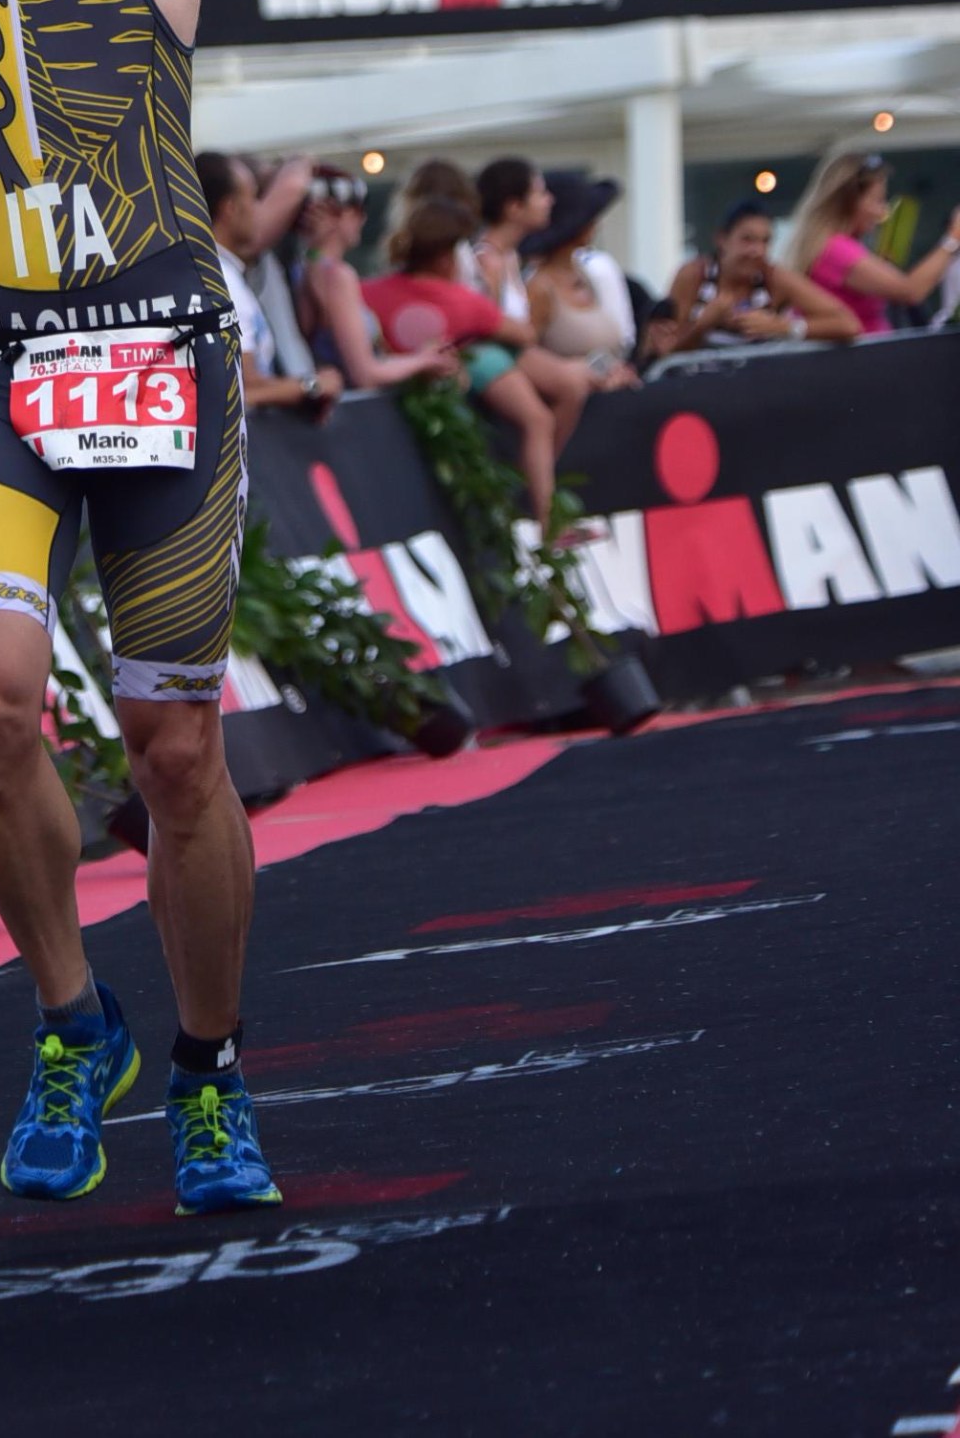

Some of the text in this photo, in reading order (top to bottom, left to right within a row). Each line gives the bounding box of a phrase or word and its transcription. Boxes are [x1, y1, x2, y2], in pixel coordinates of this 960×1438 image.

[5, 182, 118, 279] ITA
[29, 339, 102, 365] IRONMAN
[29, 362, 58, 377] 70.3
[26, 372, 186, 427] 1113
[78, 432, 139, 450] Mario
[57, 454, 159, 465] ITA M35-39 M
